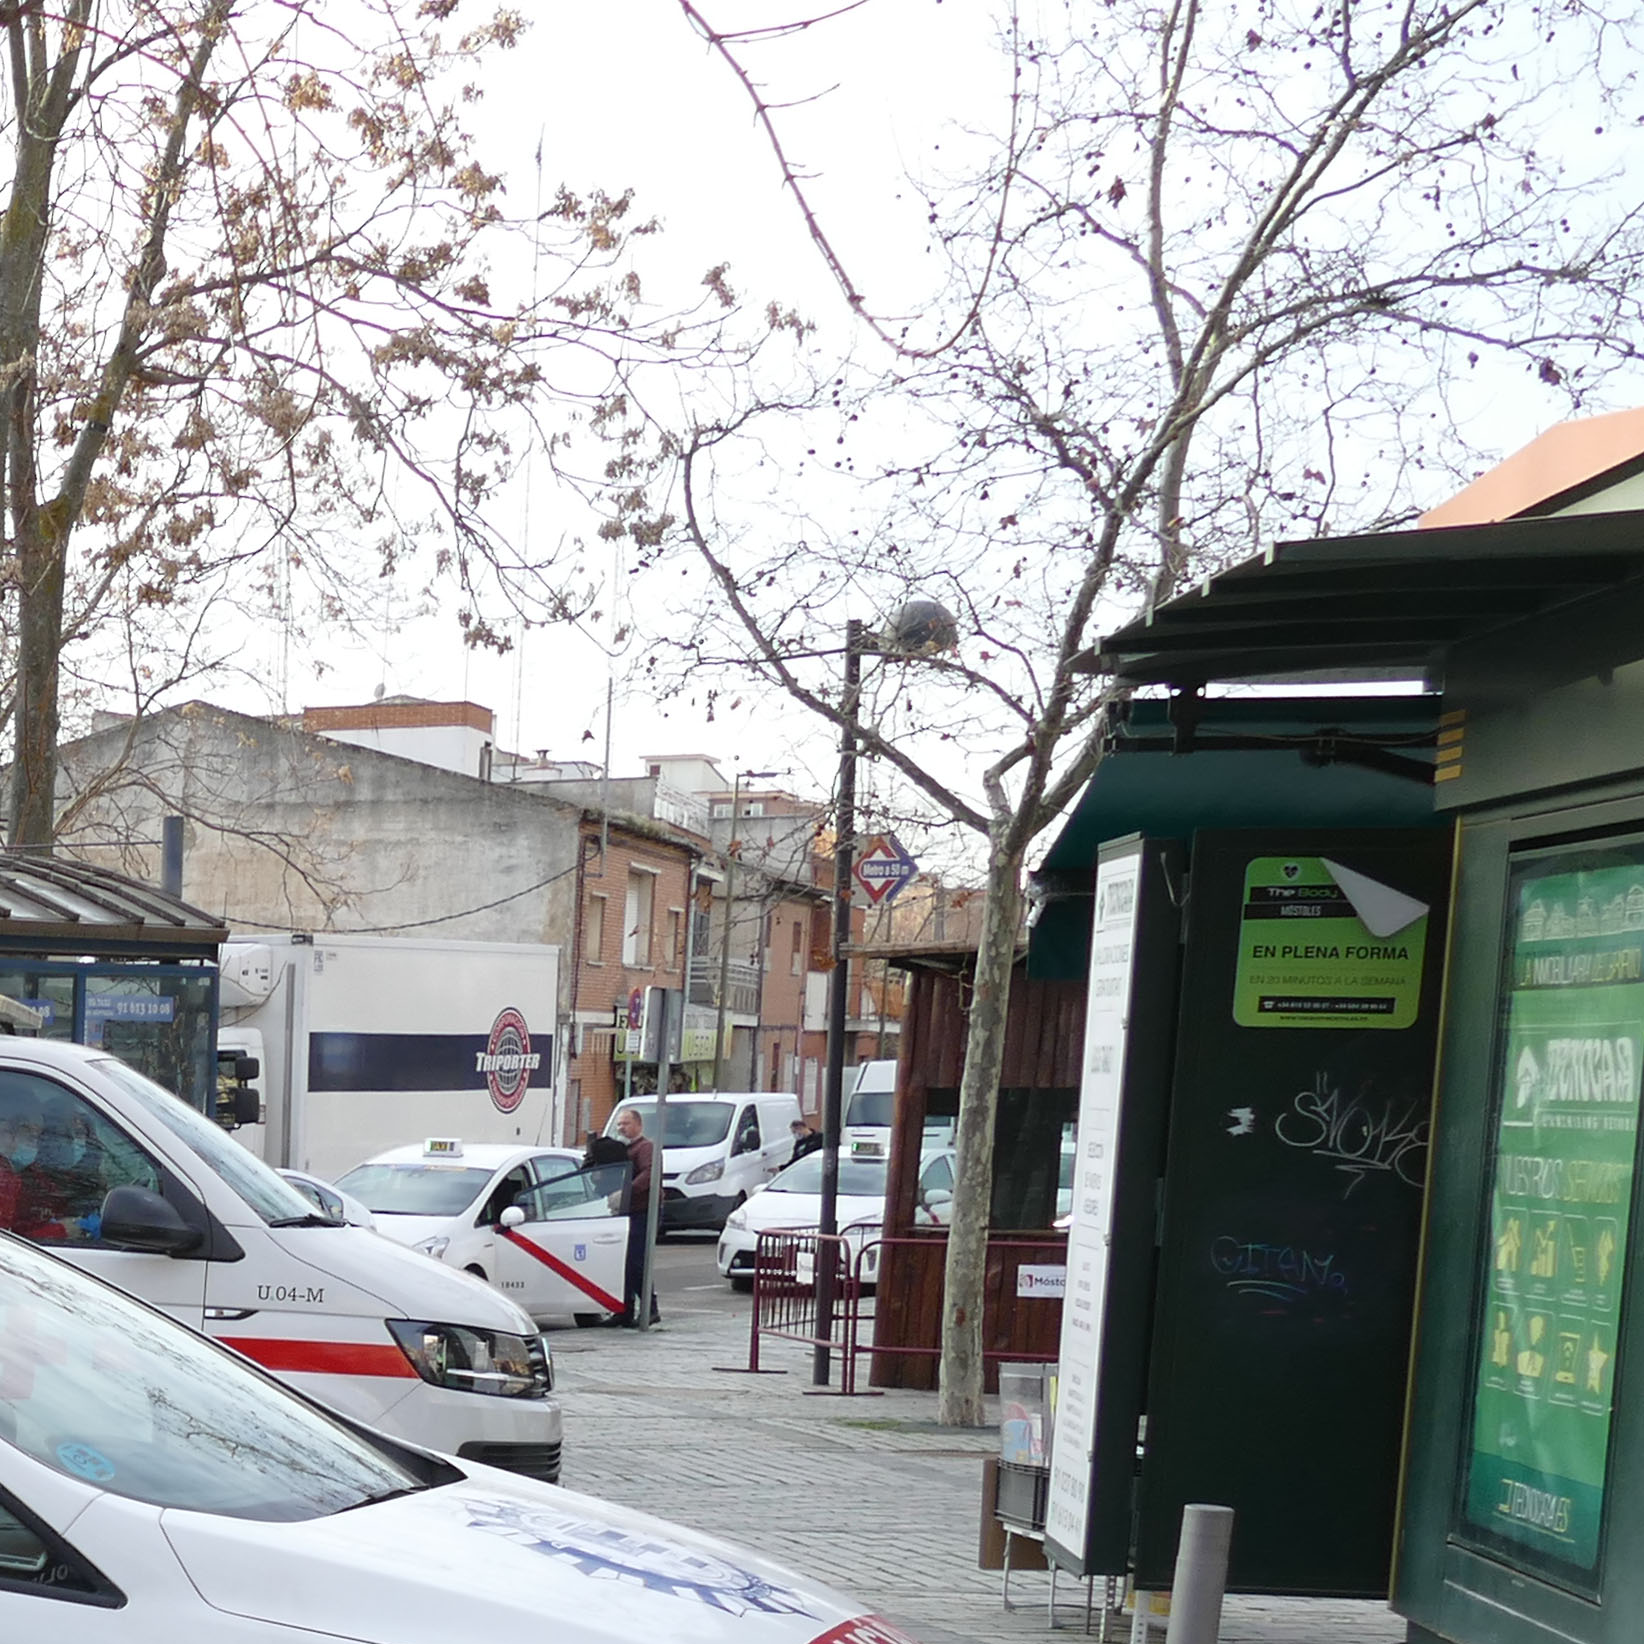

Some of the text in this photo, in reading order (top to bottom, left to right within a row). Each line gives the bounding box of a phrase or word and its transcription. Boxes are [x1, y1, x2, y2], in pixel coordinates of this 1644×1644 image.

[863, 863, 884, 876] Metro
[1267, 887, 1296, 897] The
[1252, 945, 1409, 961] EN PLENA FORMA
[475, 1052, 541, 1072] TRIPORTER
[1035, 1275, 1066, 1287] Mósto
